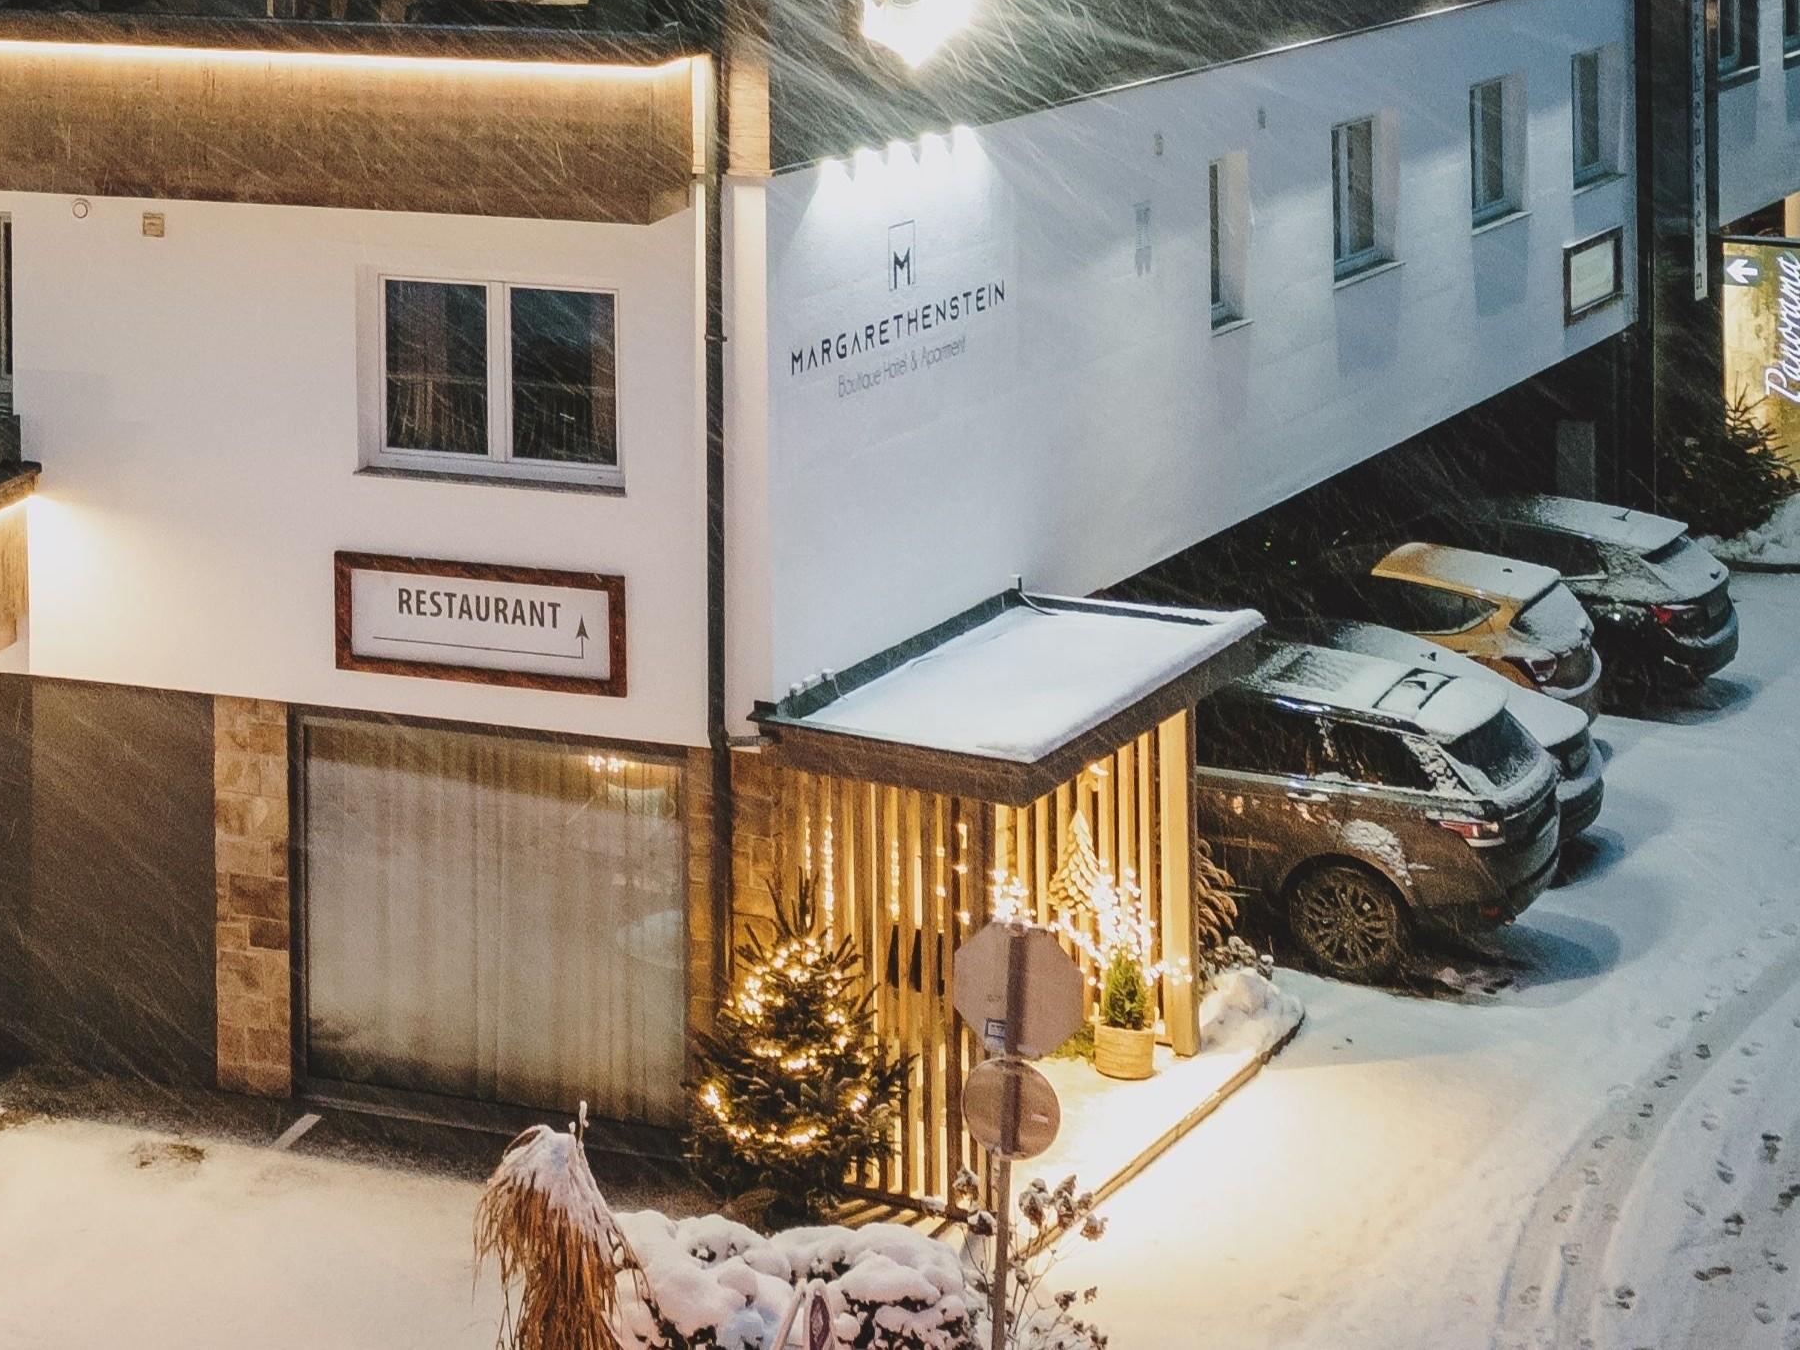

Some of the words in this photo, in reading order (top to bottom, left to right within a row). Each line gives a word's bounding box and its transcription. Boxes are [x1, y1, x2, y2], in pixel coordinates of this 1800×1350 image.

[893, 247, 911, 290] M
[791, 280, 1005, 375] MARGARETHENSTEIN
[398, 588, 561, 629] RESTAURANT
